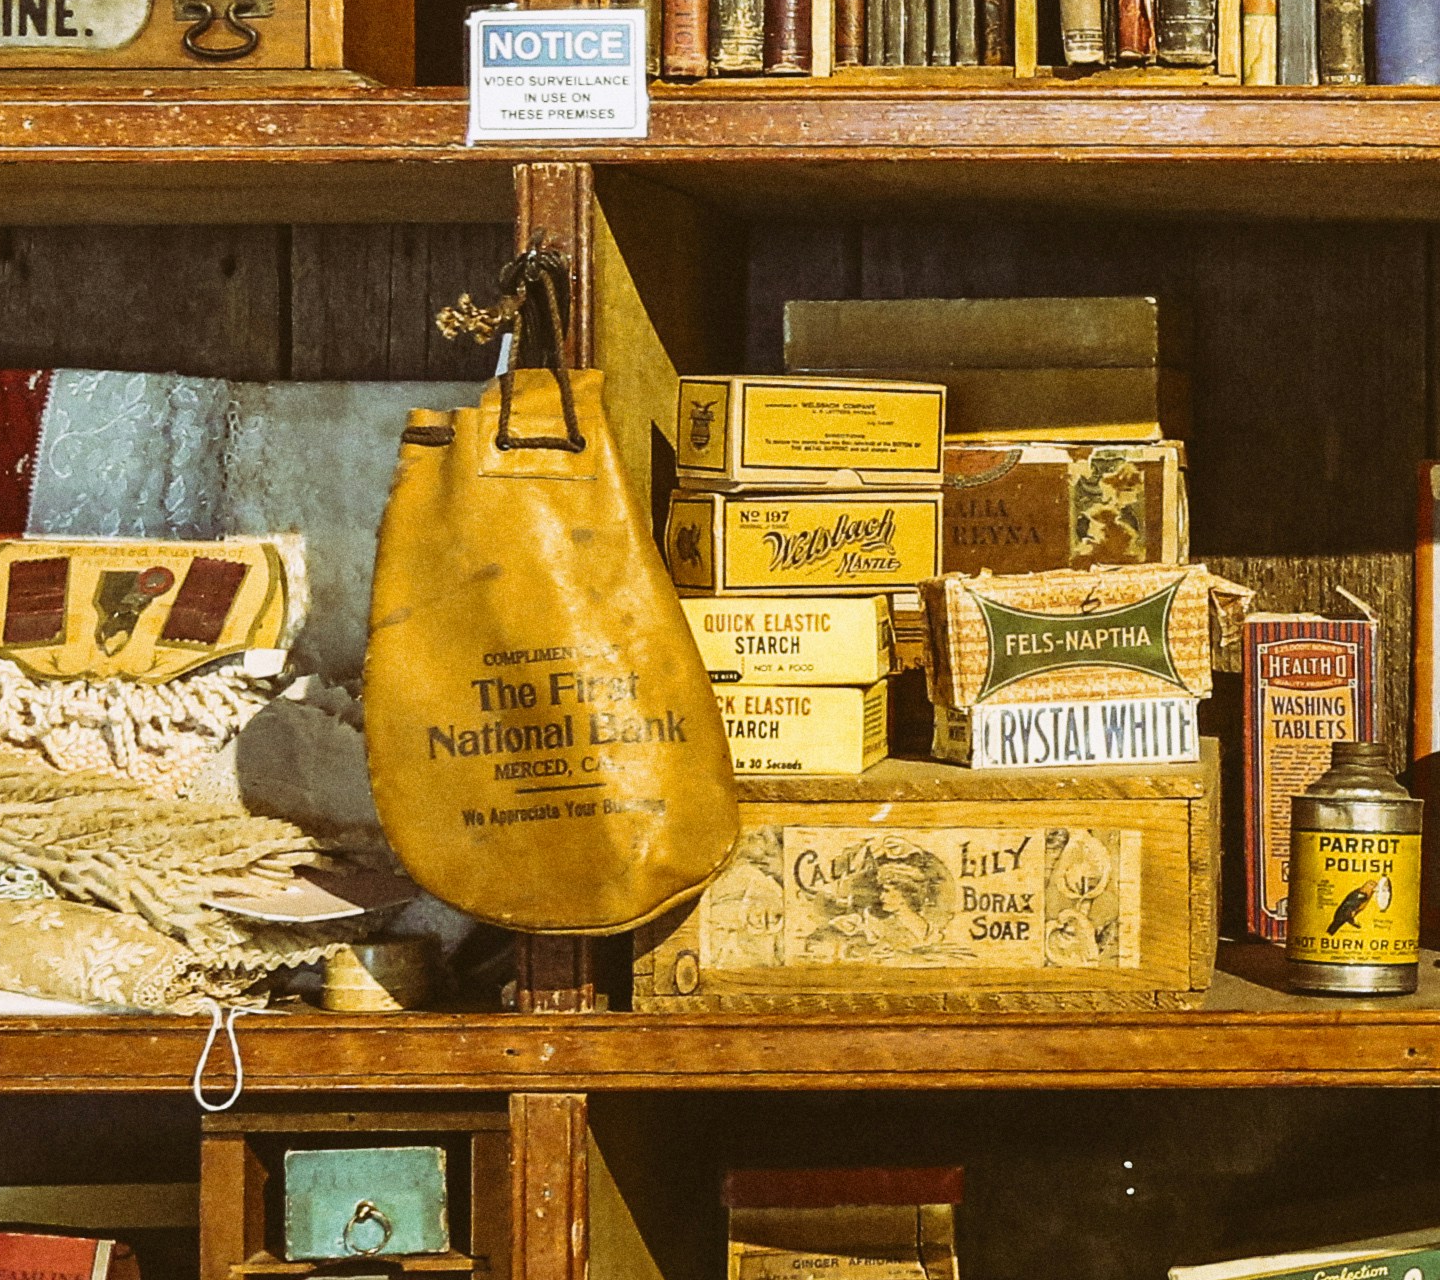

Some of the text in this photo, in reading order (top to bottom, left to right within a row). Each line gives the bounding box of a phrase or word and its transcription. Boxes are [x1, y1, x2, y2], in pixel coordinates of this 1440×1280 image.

[488, 31, 624, 60] NOTICE
[484, 75, 629, 86] VIDEO SURVEILLANCE
[524, 93, 591, 103] IN USE ON
[501, 108, 615, 120] THESE PREMISES
[763, 509, 896, 571] Welsbach
[704, 612, 831, 634] QUICK ELASTIC
[735, 635, 801, 655] STARCH
[1005, 624, 1152, 656] FELS-NAPTHA
[471, 669, 640, 714] The First
[1270, 695, 1346, 718] WASHING
[427, 709, 687, 762] National Bank
[1105, 697, 1192, 760] WHITE
[1273, 718, 1346, 740] TABLETS
[494, 756, 573, 781] MERCED,
[490, 799, 597, 825] Appreciate Your
[960, 837, 1032, 878] LILY
[1319, 837, 1400, 854] PARROT
[1324, 857, 1394, 875] POLISH
[963, 887, 1033, 914] BORAX
[792, 1257, 840, 1270] GINGER
